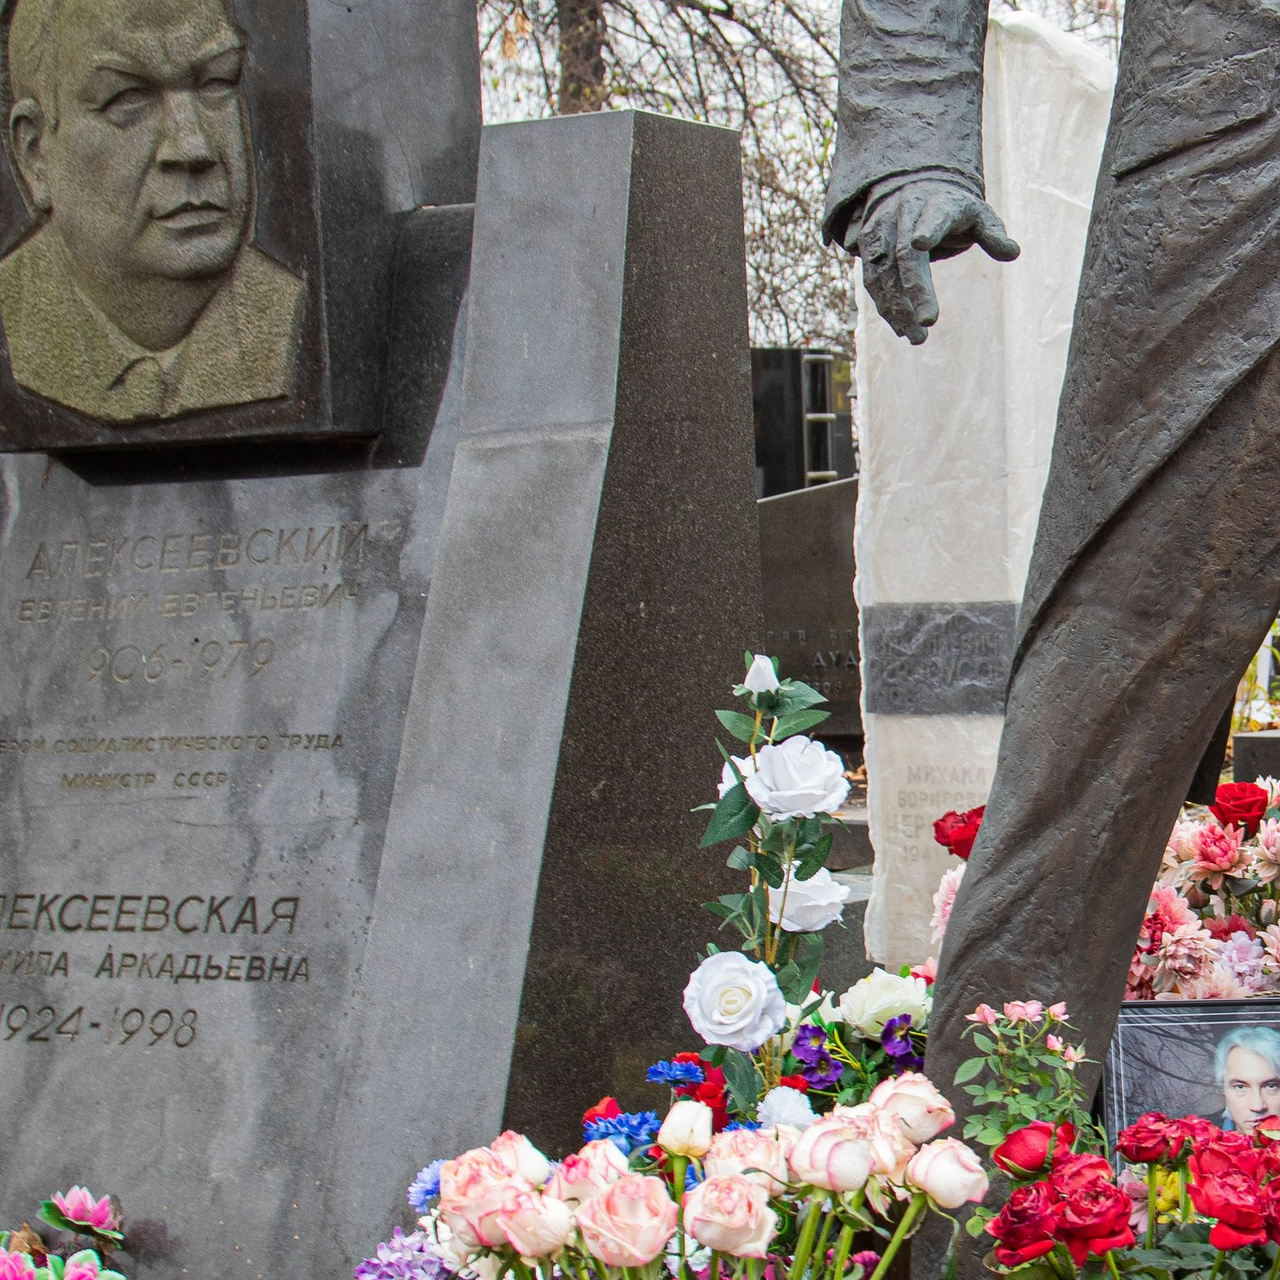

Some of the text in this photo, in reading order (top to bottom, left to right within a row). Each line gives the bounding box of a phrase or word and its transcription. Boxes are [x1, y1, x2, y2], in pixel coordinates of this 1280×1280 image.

[279, 733, 345, 752] ТРУДА
[173, 770, 229, 789] СССР
[94, 951, 311, 985] АРКАДЬЕВНА
